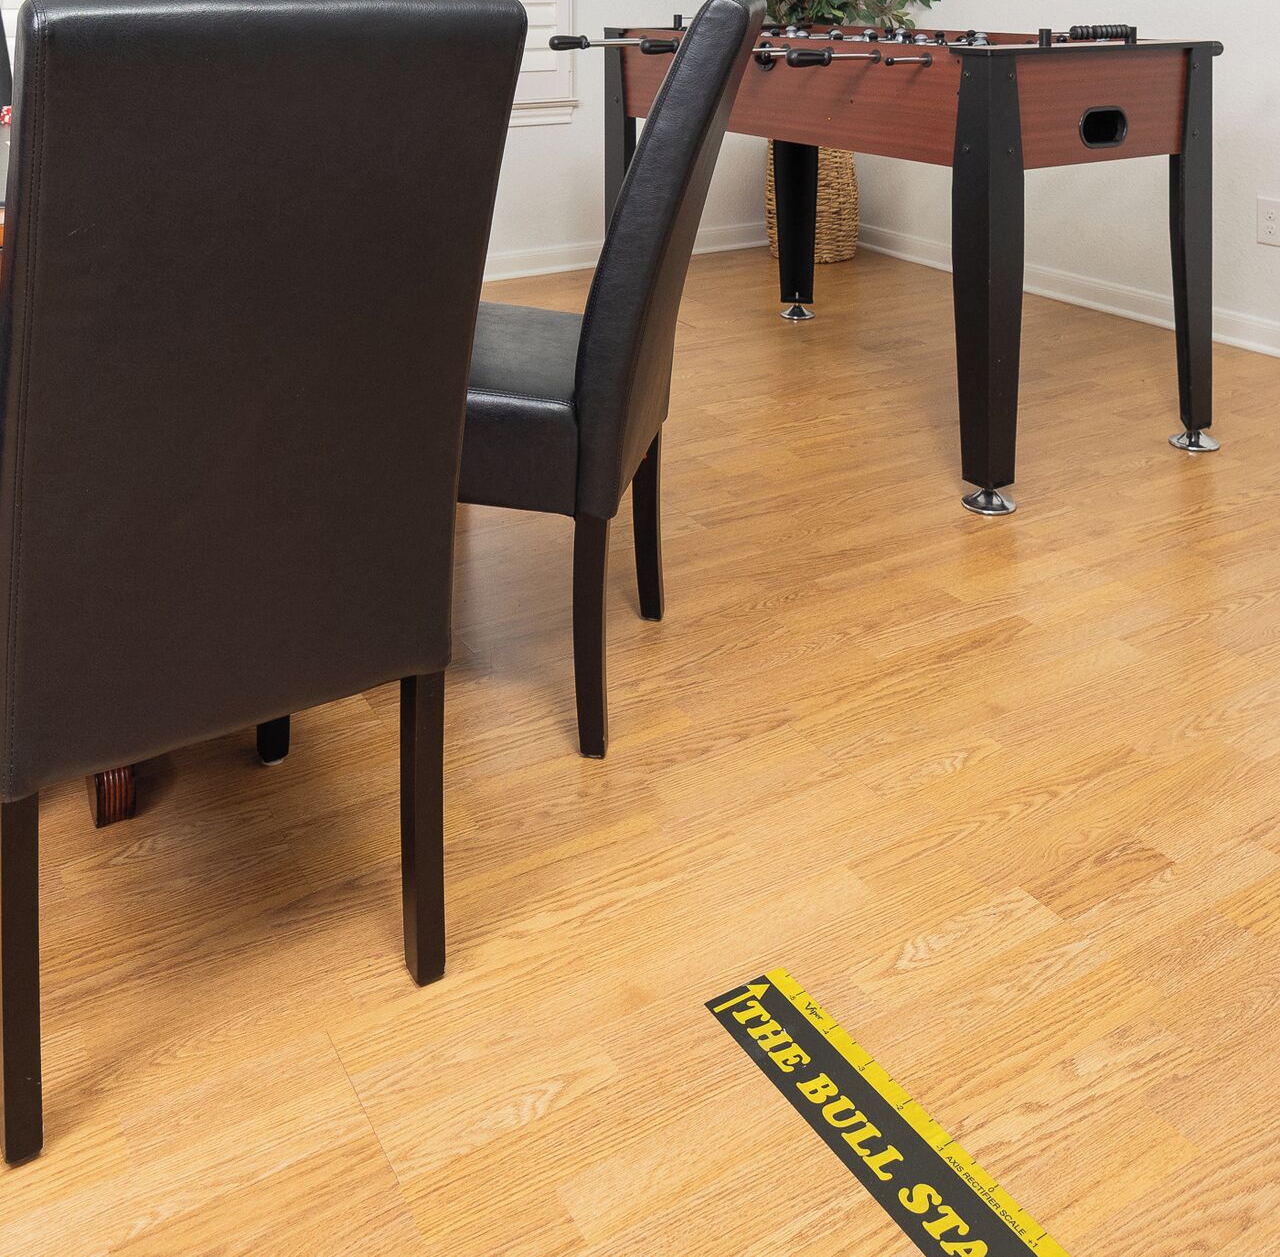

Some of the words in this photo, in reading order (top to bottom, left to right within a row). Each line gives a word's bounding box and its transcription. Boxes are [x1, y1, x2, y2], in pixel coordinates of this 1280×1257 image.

[804, 1002, 824, 1021] Viper
[732, 998, 811, 1073] THE
[795, 1072, 904, 1181] BULL
[945, 1155, 965, 1173] AXIS
[962, 1171, 1001, 1211] RECTIFIER
[999, 1209, 1027, 1237] SCALE
[1027, 1239, 1038, 1248] +1
